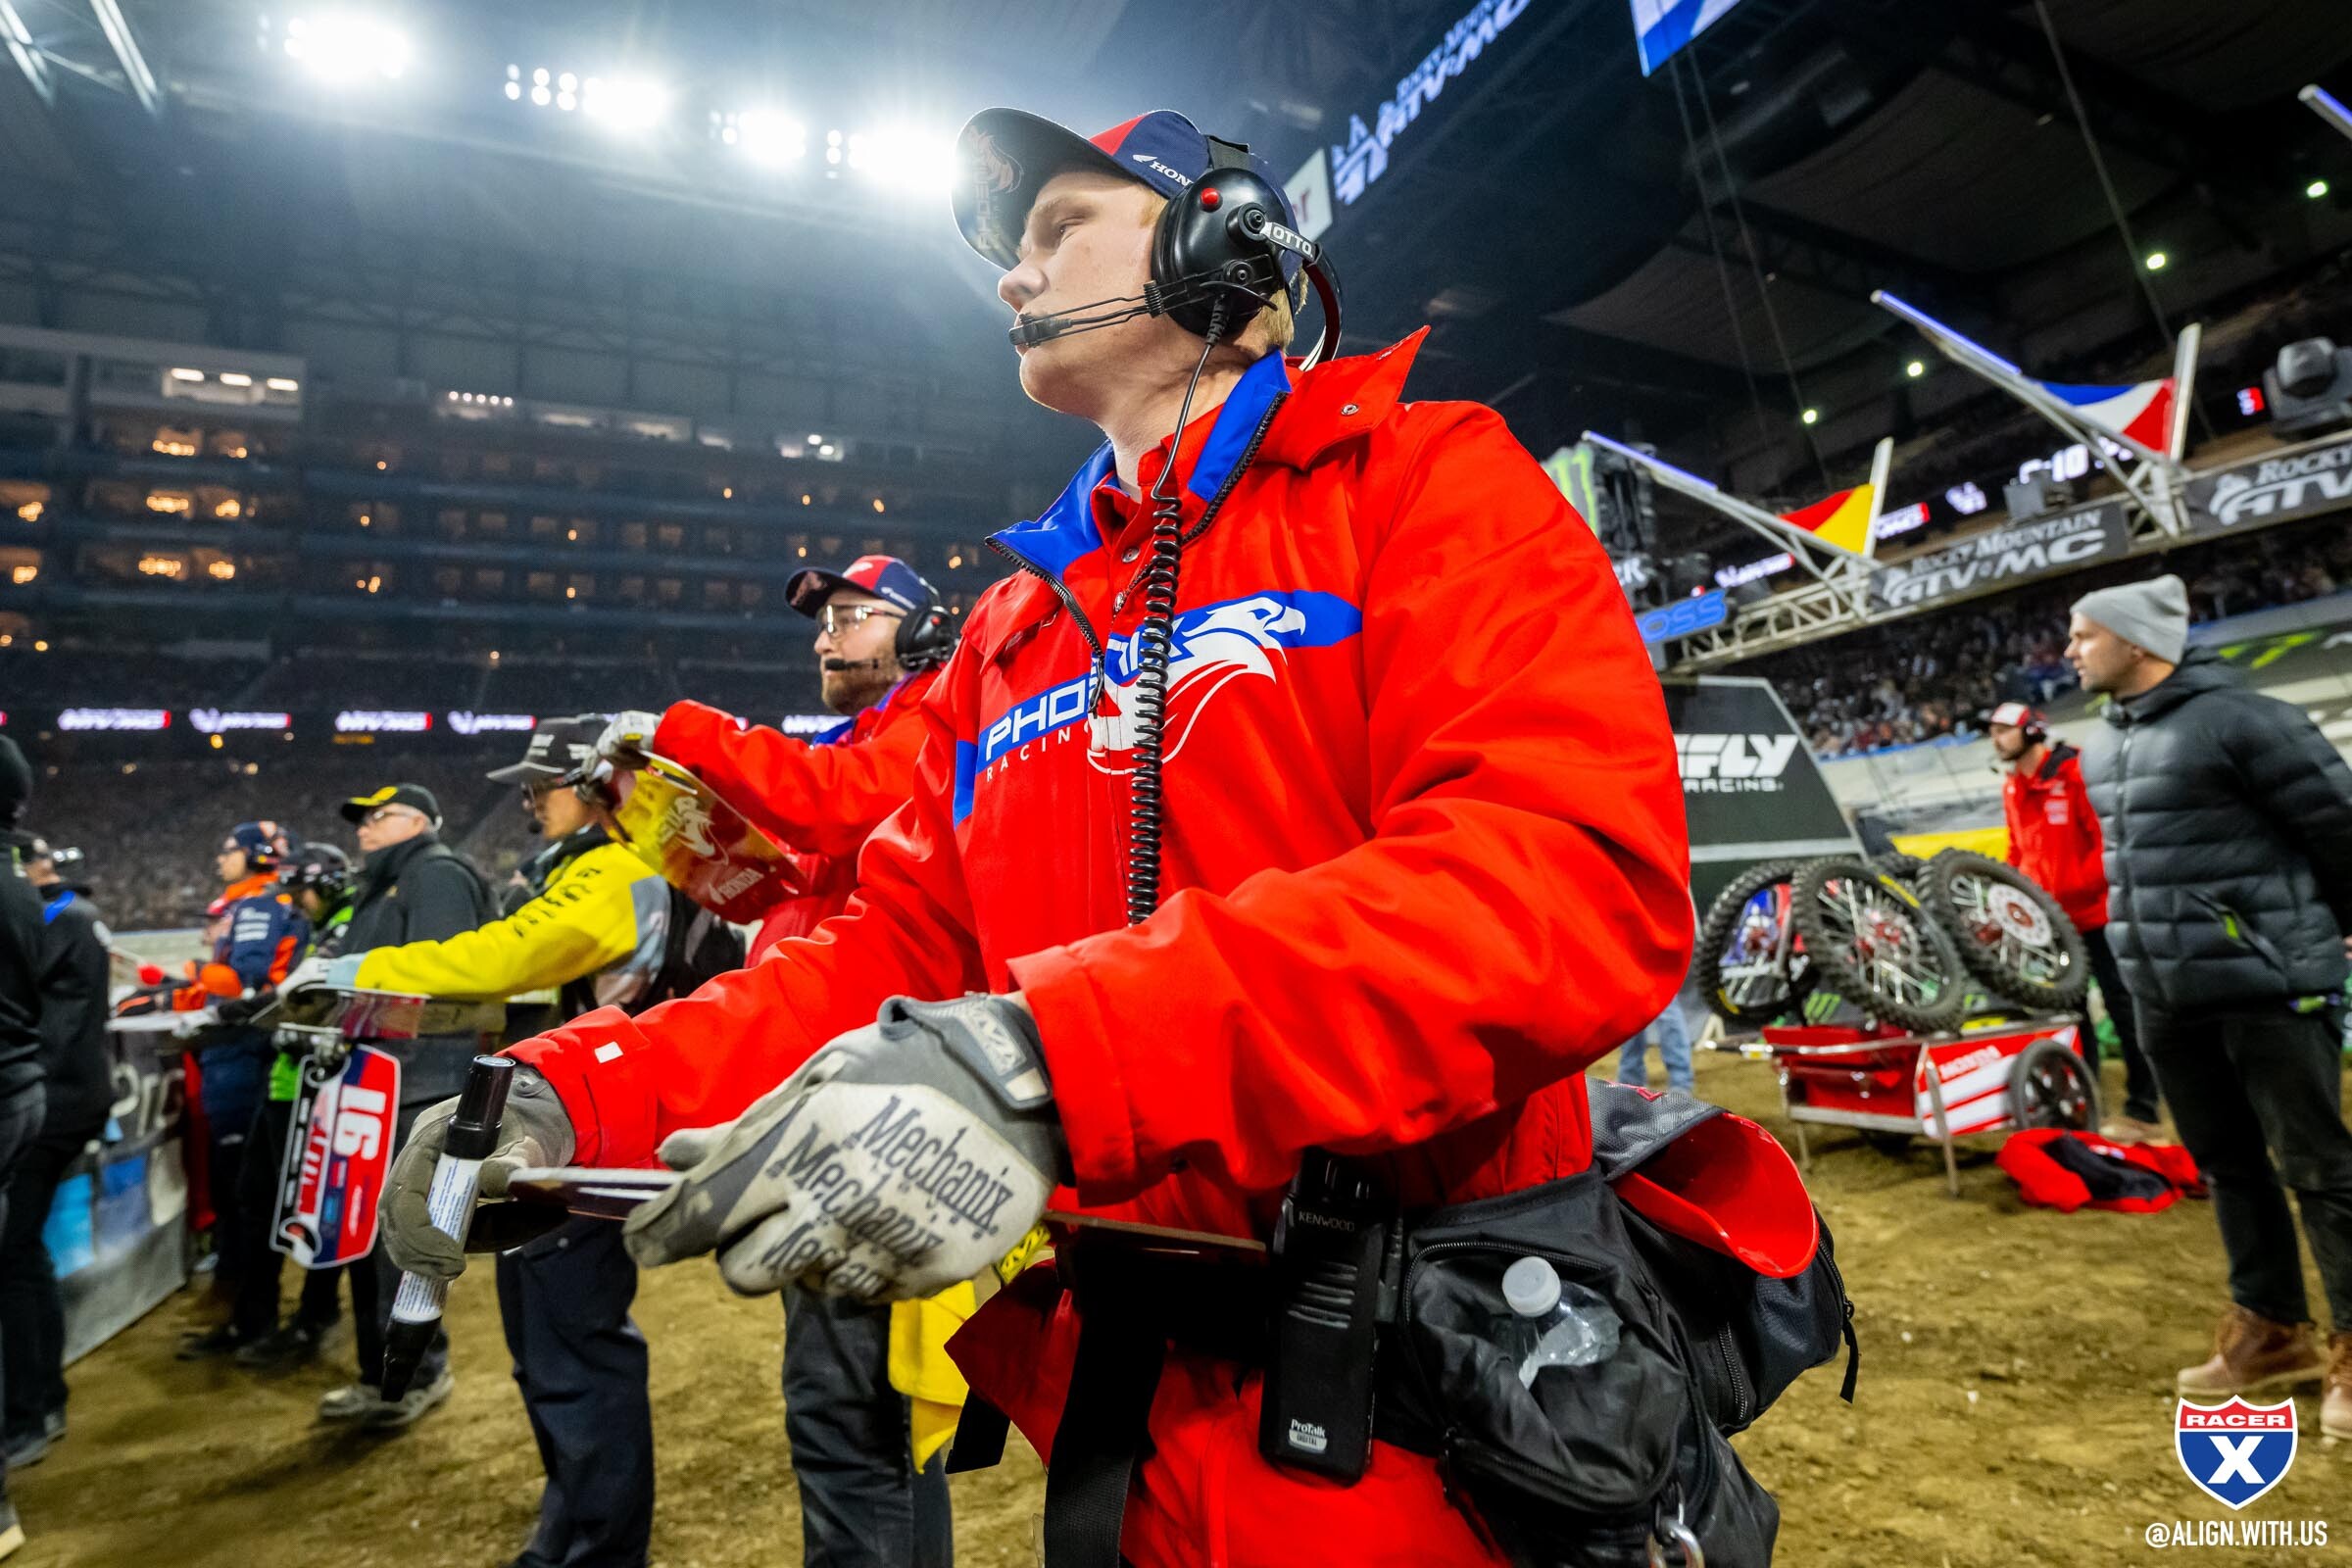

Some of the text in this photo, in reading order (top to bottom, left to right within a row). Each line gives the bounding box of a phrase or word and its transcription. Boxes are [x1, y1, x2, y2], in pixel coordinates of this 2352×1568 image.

[1273, 226, 1312, 256] OTTO
[987, 720, 1088, 782] RACIN
[1674, 734, 1799, 777] FLY
[1683, 778, 1778, 793] RACING
[847, 1095, 1013, 1238] Mechanix
[768, 1123, 945, 1268] Mechanix
[1298, 1210, 1355, 1232] KENWOOD
[1291, 1418, 1326, 1439] ProTalk
